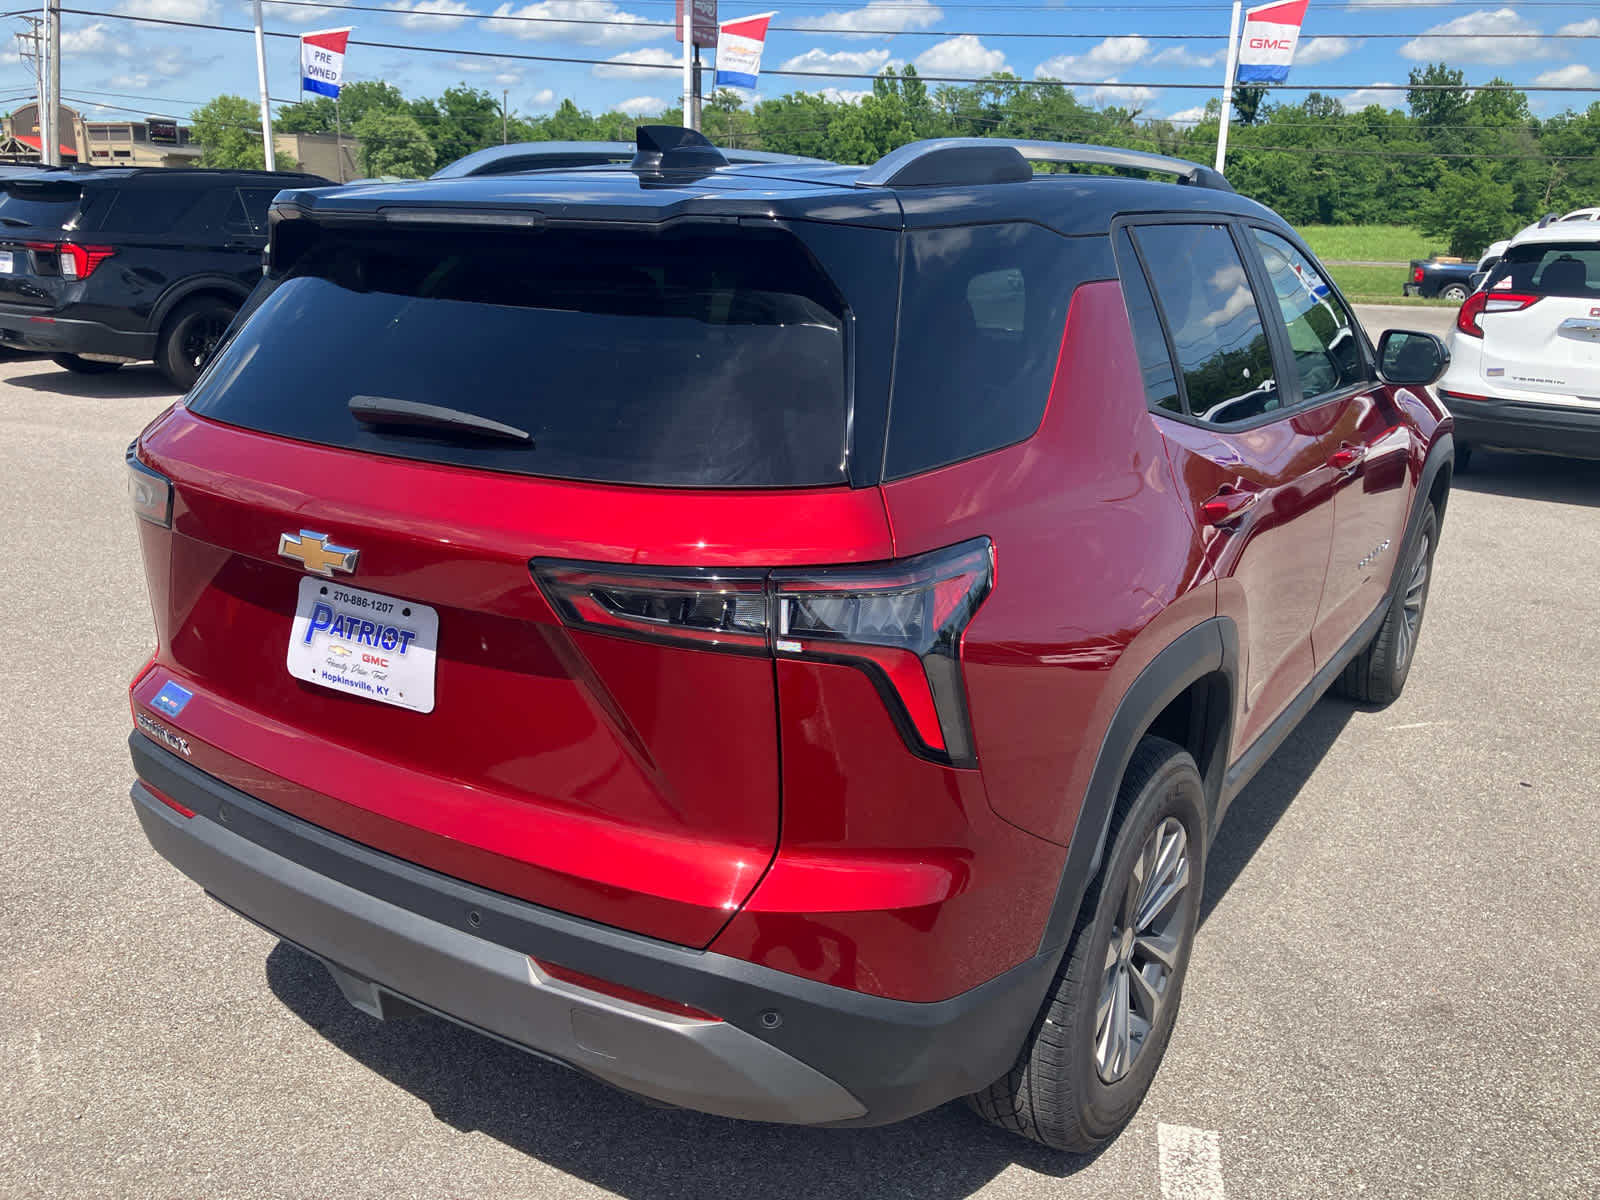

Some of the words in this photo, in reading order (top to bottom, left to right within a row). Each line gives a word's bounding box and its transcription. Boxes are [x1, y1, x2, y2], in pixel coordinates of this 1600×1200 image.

[1249, 38, 1292, 50] GMC
[314, 50, 333, 65] PRE
[308, 64, 337, 81] OWNED
[334, 591, 393, 613] 270-886-1207
[304, 603, 415, 654] PATRIOT
[361, 653, 390, 668] GMC
[321, 671, 374, 693] Hopkinsville,
[376, 686, 389, 696] KY
